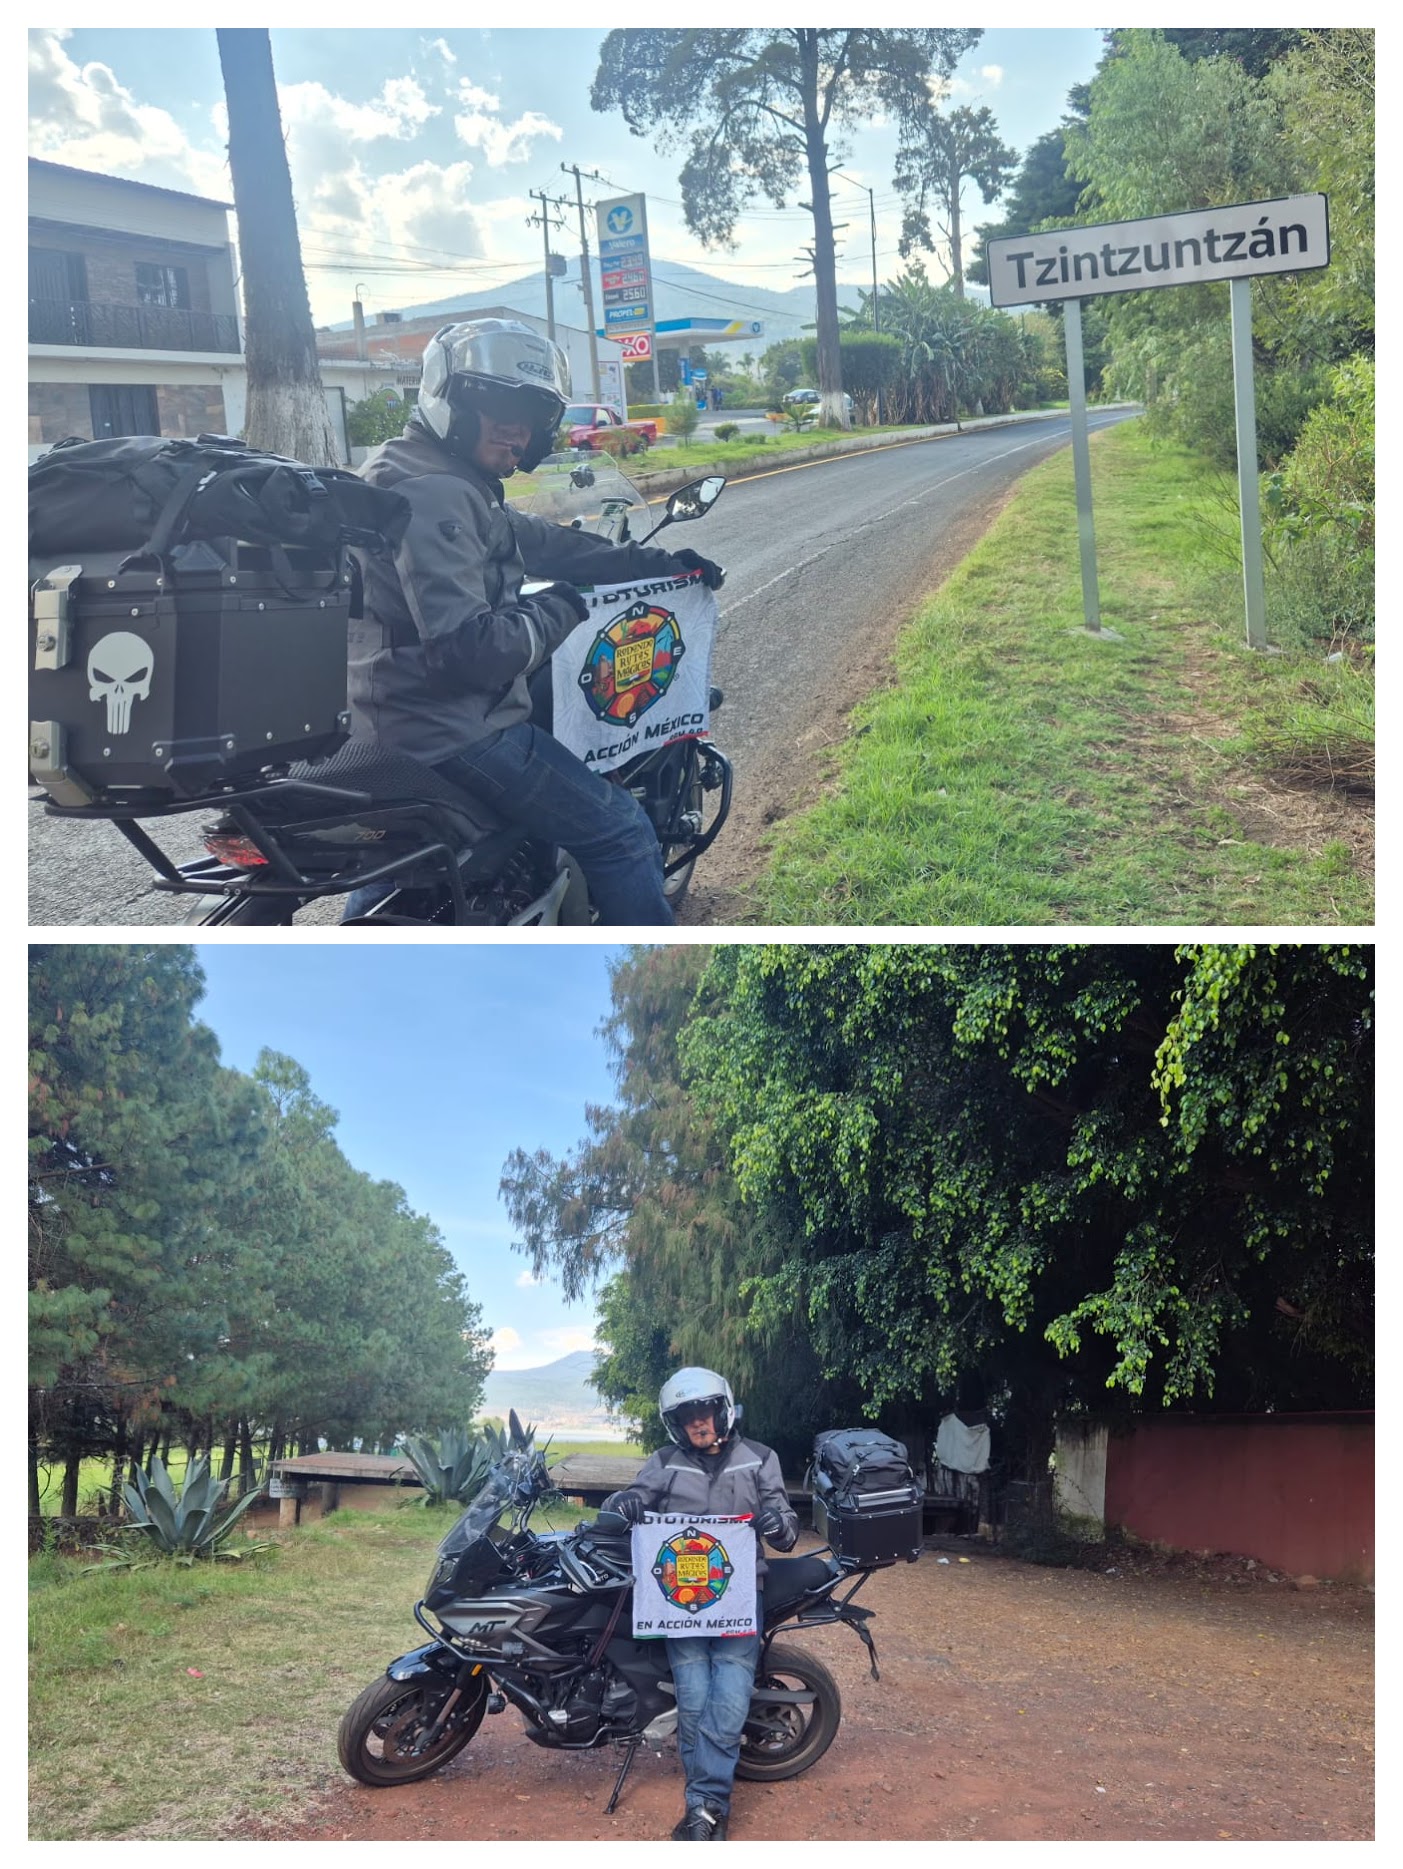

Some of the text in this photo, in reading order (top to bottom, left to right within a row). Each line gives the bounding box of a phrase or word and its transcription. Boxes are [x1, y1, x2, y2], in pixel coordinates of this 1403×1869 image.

[608, 239, 635, 249] Valero
[1007, 216, 1307, 289] Tzintzuntzán
[632, 605, 644, 616] N
[673, 646, 682, 656] E
[629, 712, 637, 723] S
[584, 731, 639, 764] ACCIÓN
[645, 713, 704, 739] MÉXICO
[689, 1603, 698, 1611] S
[469, 1620, 507, 1634] MT
[636, 1616, 753, 1630] EN ACCIÓN MÉXICO
